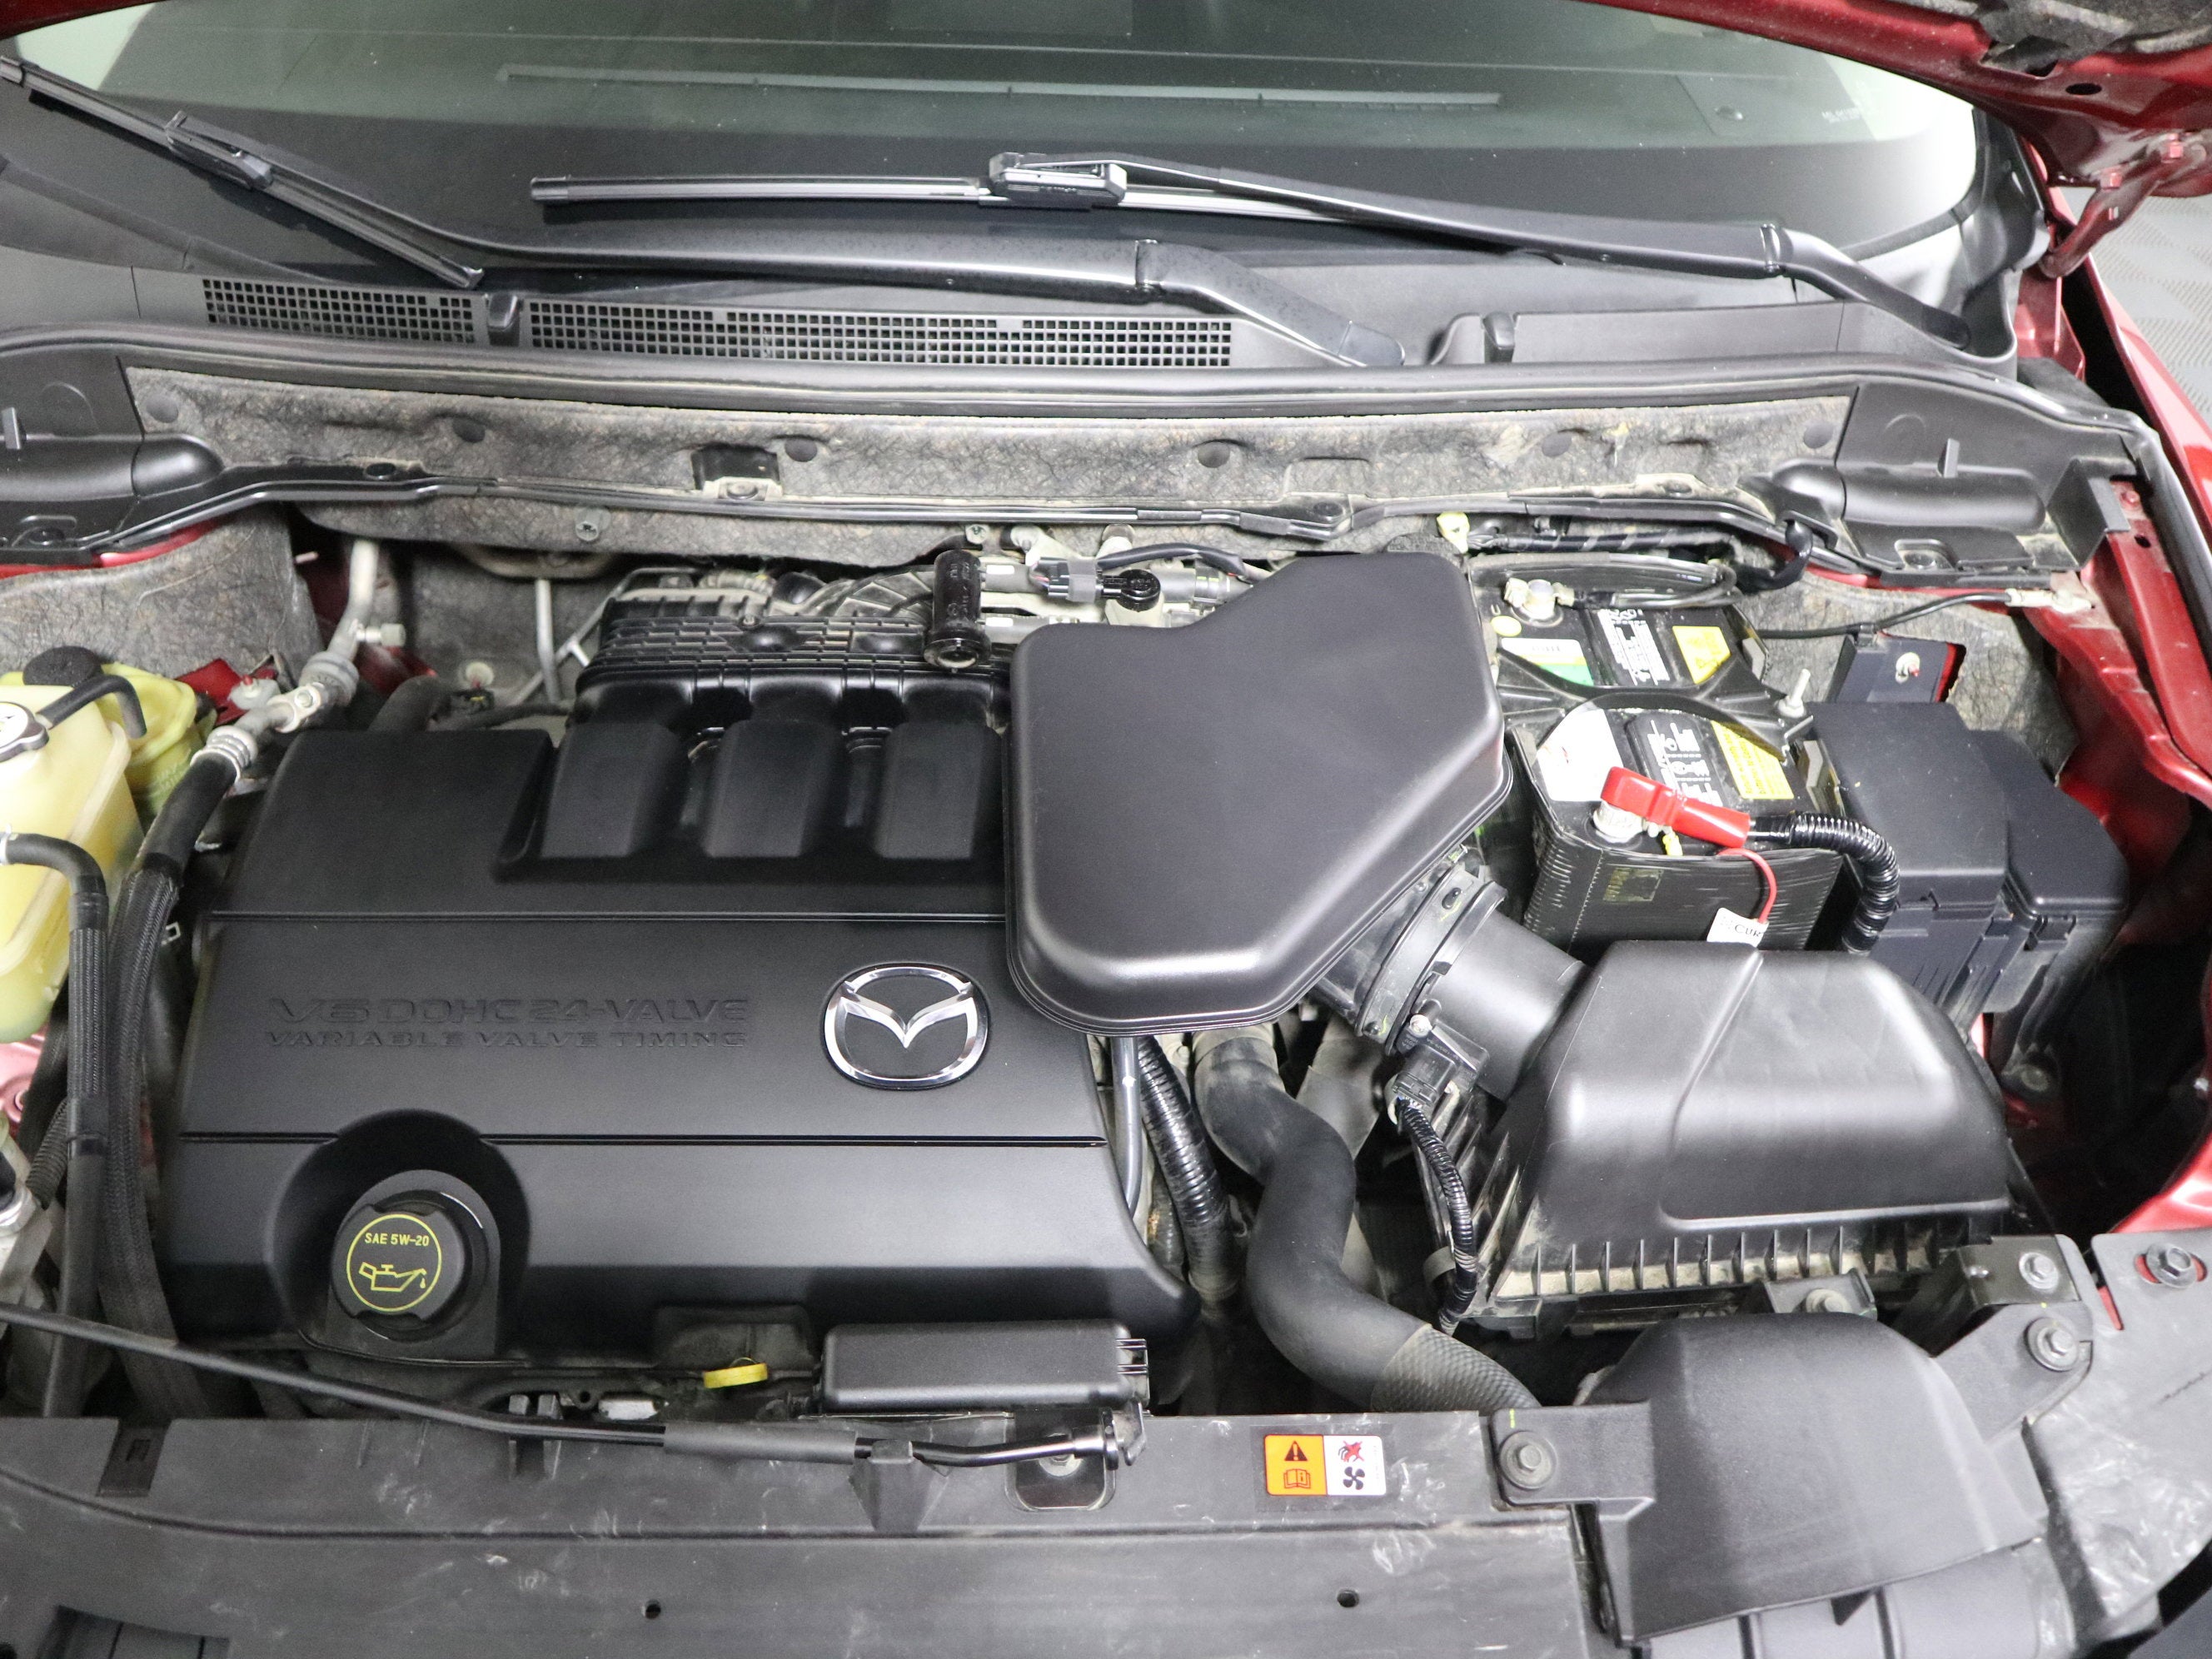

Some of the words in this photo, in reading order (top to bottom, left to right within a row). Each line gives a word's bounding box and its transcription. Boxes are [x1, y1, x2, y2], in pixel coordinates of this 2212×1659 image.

[377, 999, 521, 1024] DOHC
[527, 999, 748, 1025] 24-VALVE
[267, 1031, 462, 1048] VARIABLE
[476, 1031, 598, 1048] VALVE
[610, 1032, 746, 1048] TIMING
[365, 1233, 388, 1244] SAE
[391, 1233, 430, 1247] 5W-20
